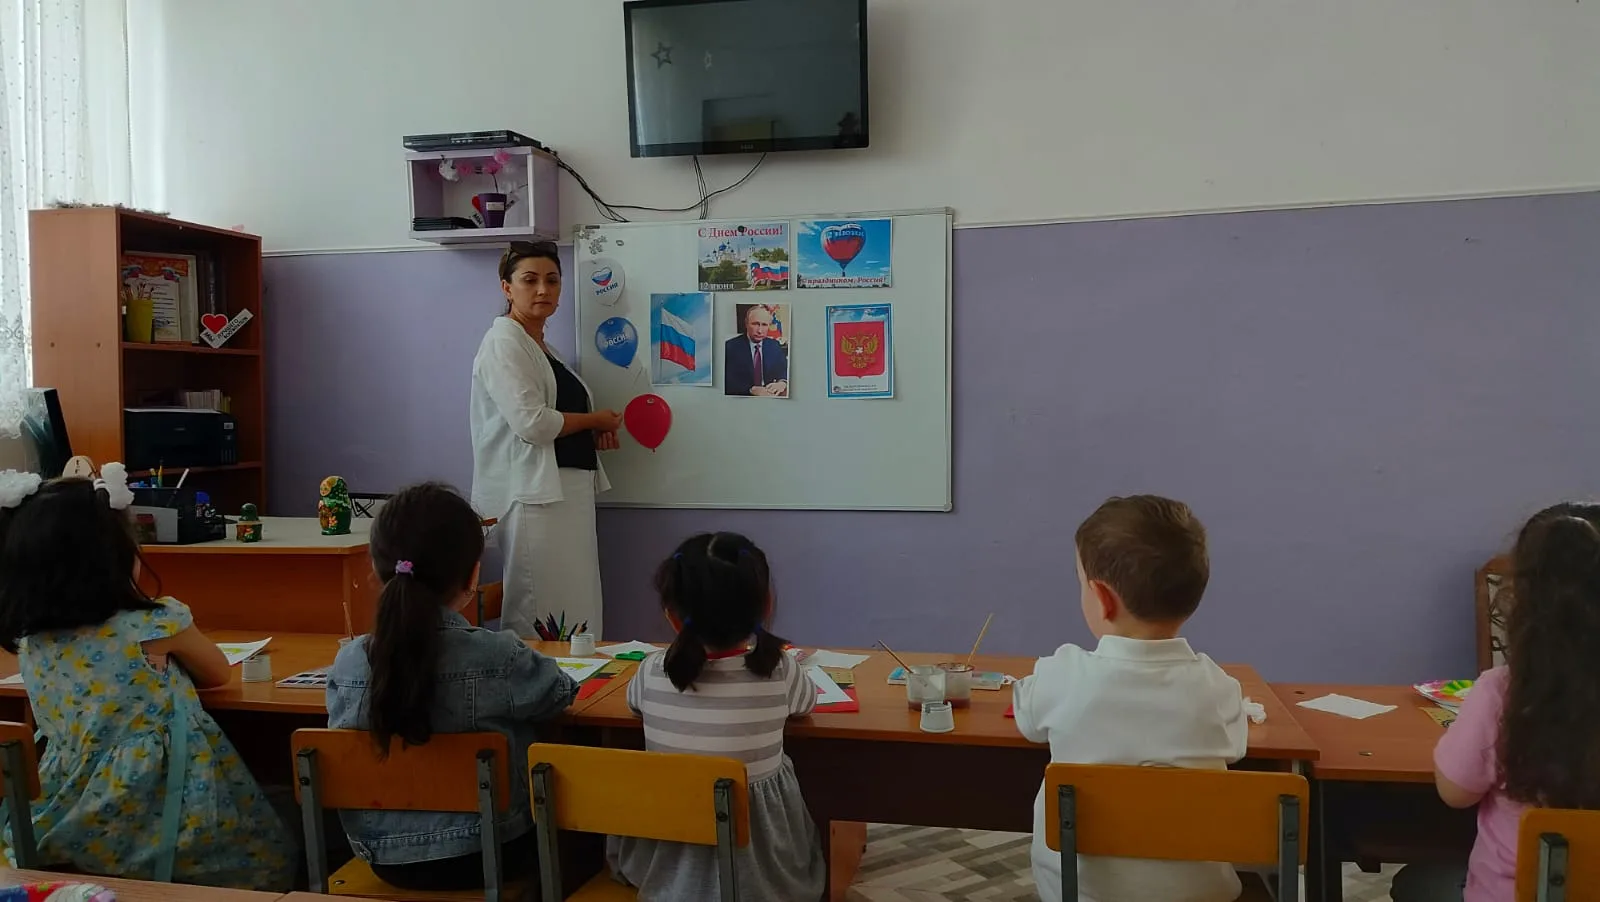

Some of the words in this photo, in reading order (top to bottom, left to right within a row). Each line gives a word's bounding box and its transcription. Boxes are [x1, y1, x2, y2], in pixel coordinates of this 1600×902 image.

[698, 228, 707, 238] С
[709, 227, 738, 239] Днем
[741, 225, 783, 237] России!
[595, 282, 619, 296] РОССИЯ
[700, 282, 709, 290] 12
[710, 282, 735, 290] июня
